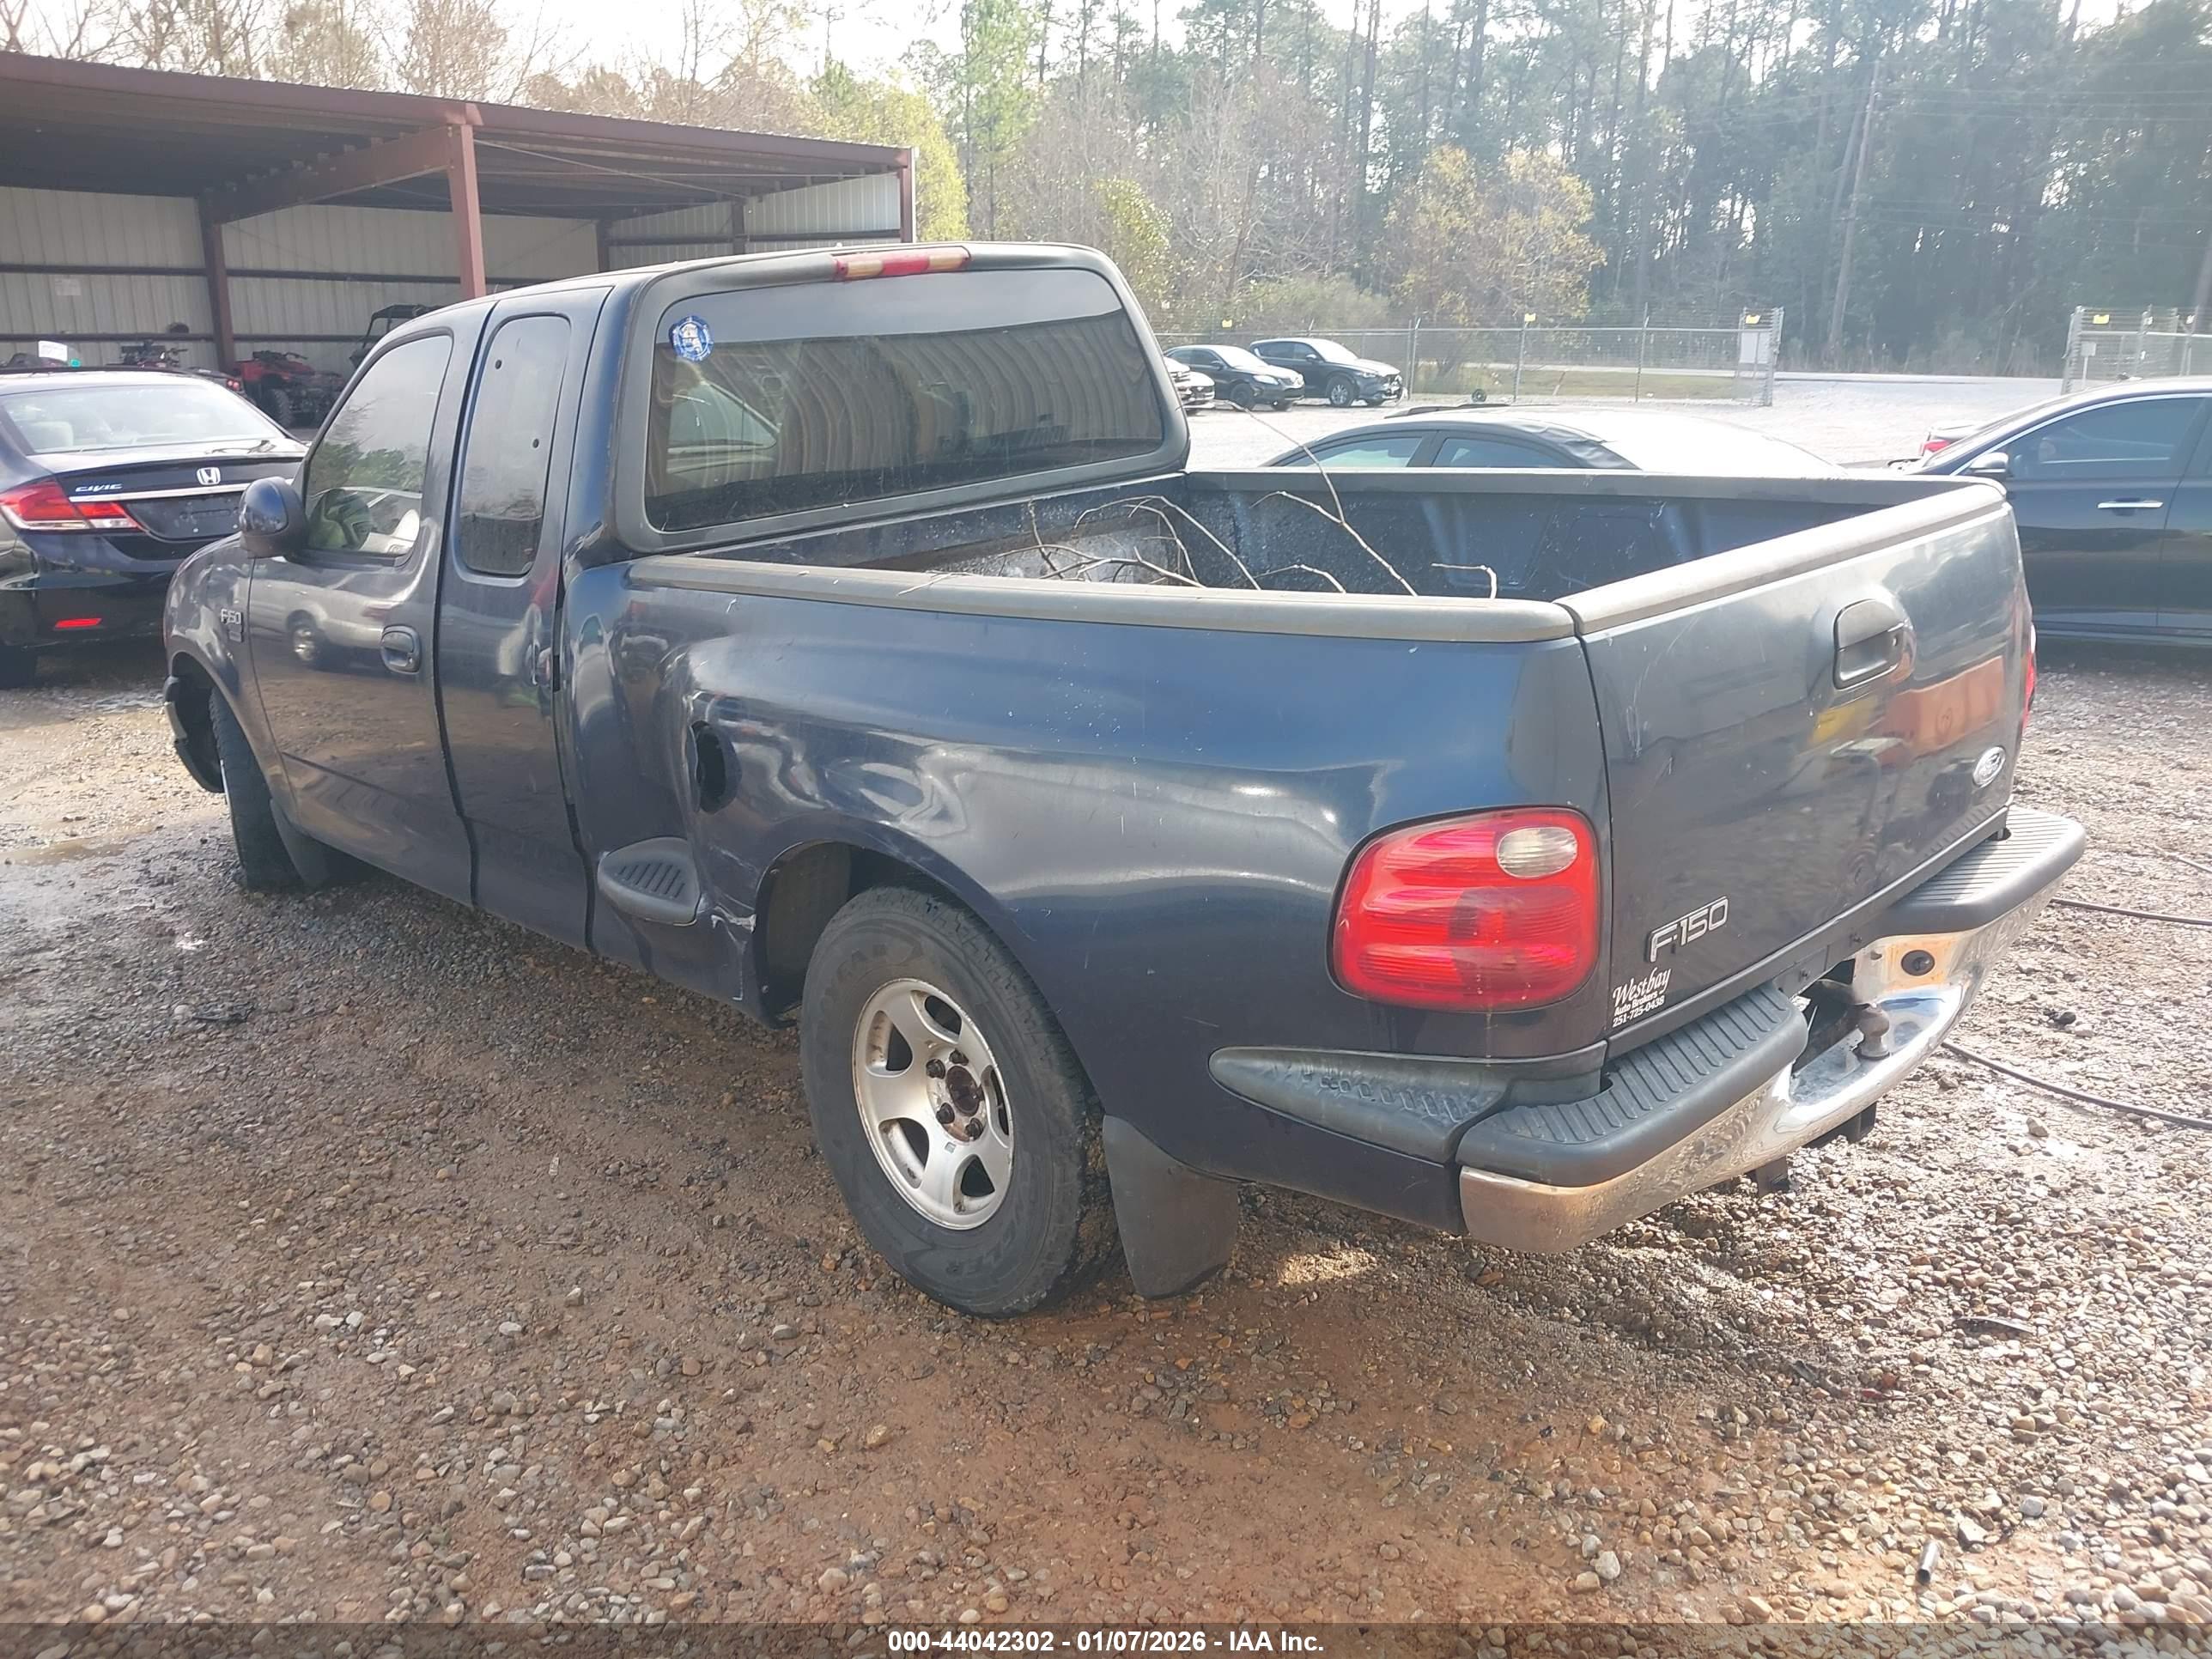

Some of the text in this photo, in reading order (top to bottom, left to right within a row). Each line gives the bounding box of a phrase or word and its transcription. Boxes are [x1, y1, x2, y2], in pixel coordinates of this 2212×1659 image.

[1612, 967, 1672, 1007] Westbay
[1613, 990, 1658, 1017] Auto Brokers
